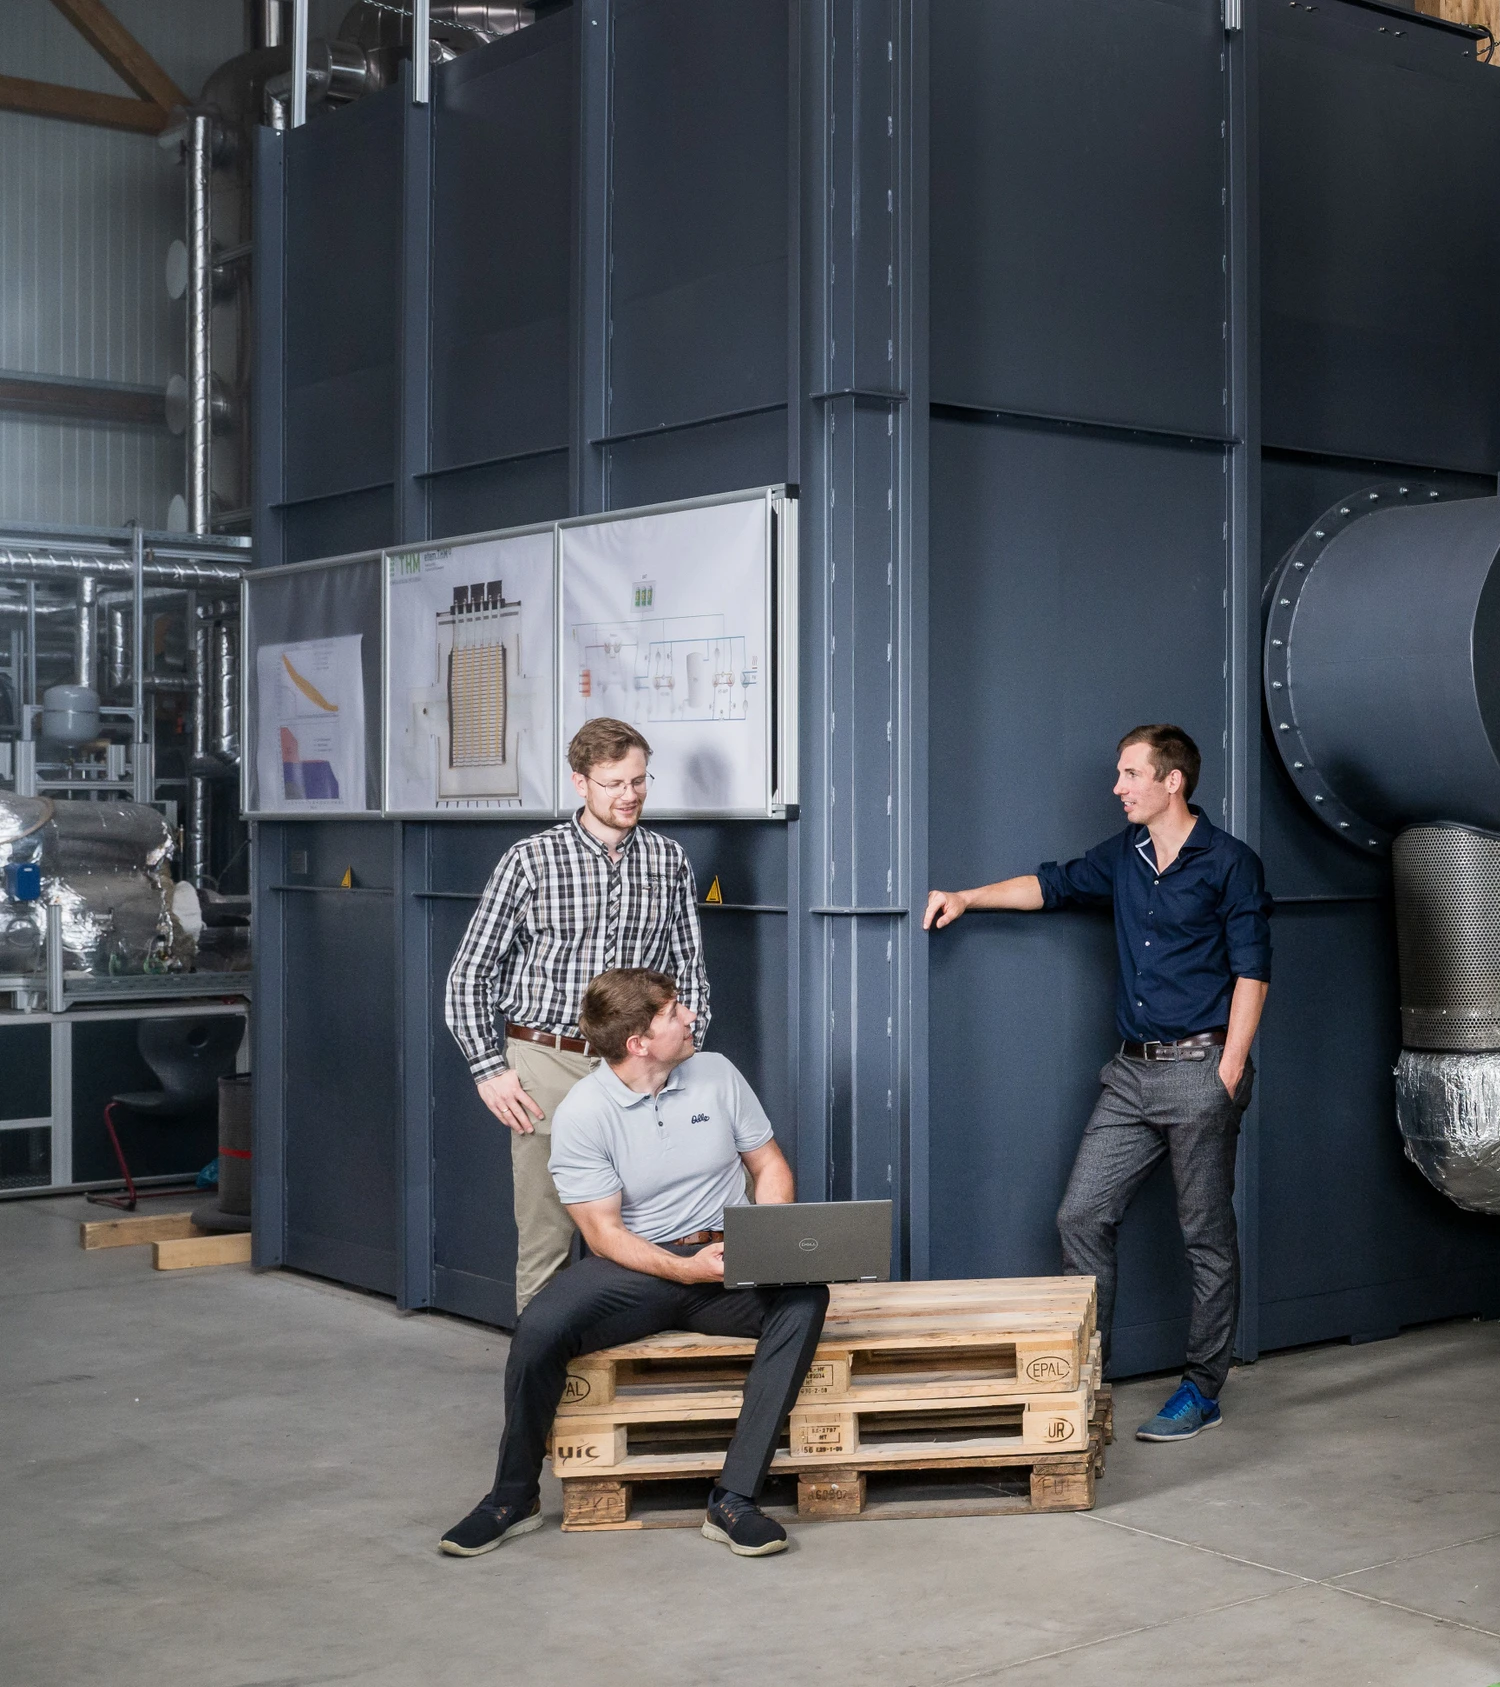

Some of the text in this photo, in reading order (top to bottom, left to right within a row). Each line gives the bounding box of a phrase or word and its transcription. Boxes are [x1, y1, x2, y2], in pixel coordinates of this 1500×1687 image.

[1033, 1362, 1065, 1378] EPAL
[566, 1381, 584, 1397] AL
[1044, 1422, 1065, 1438] UR
